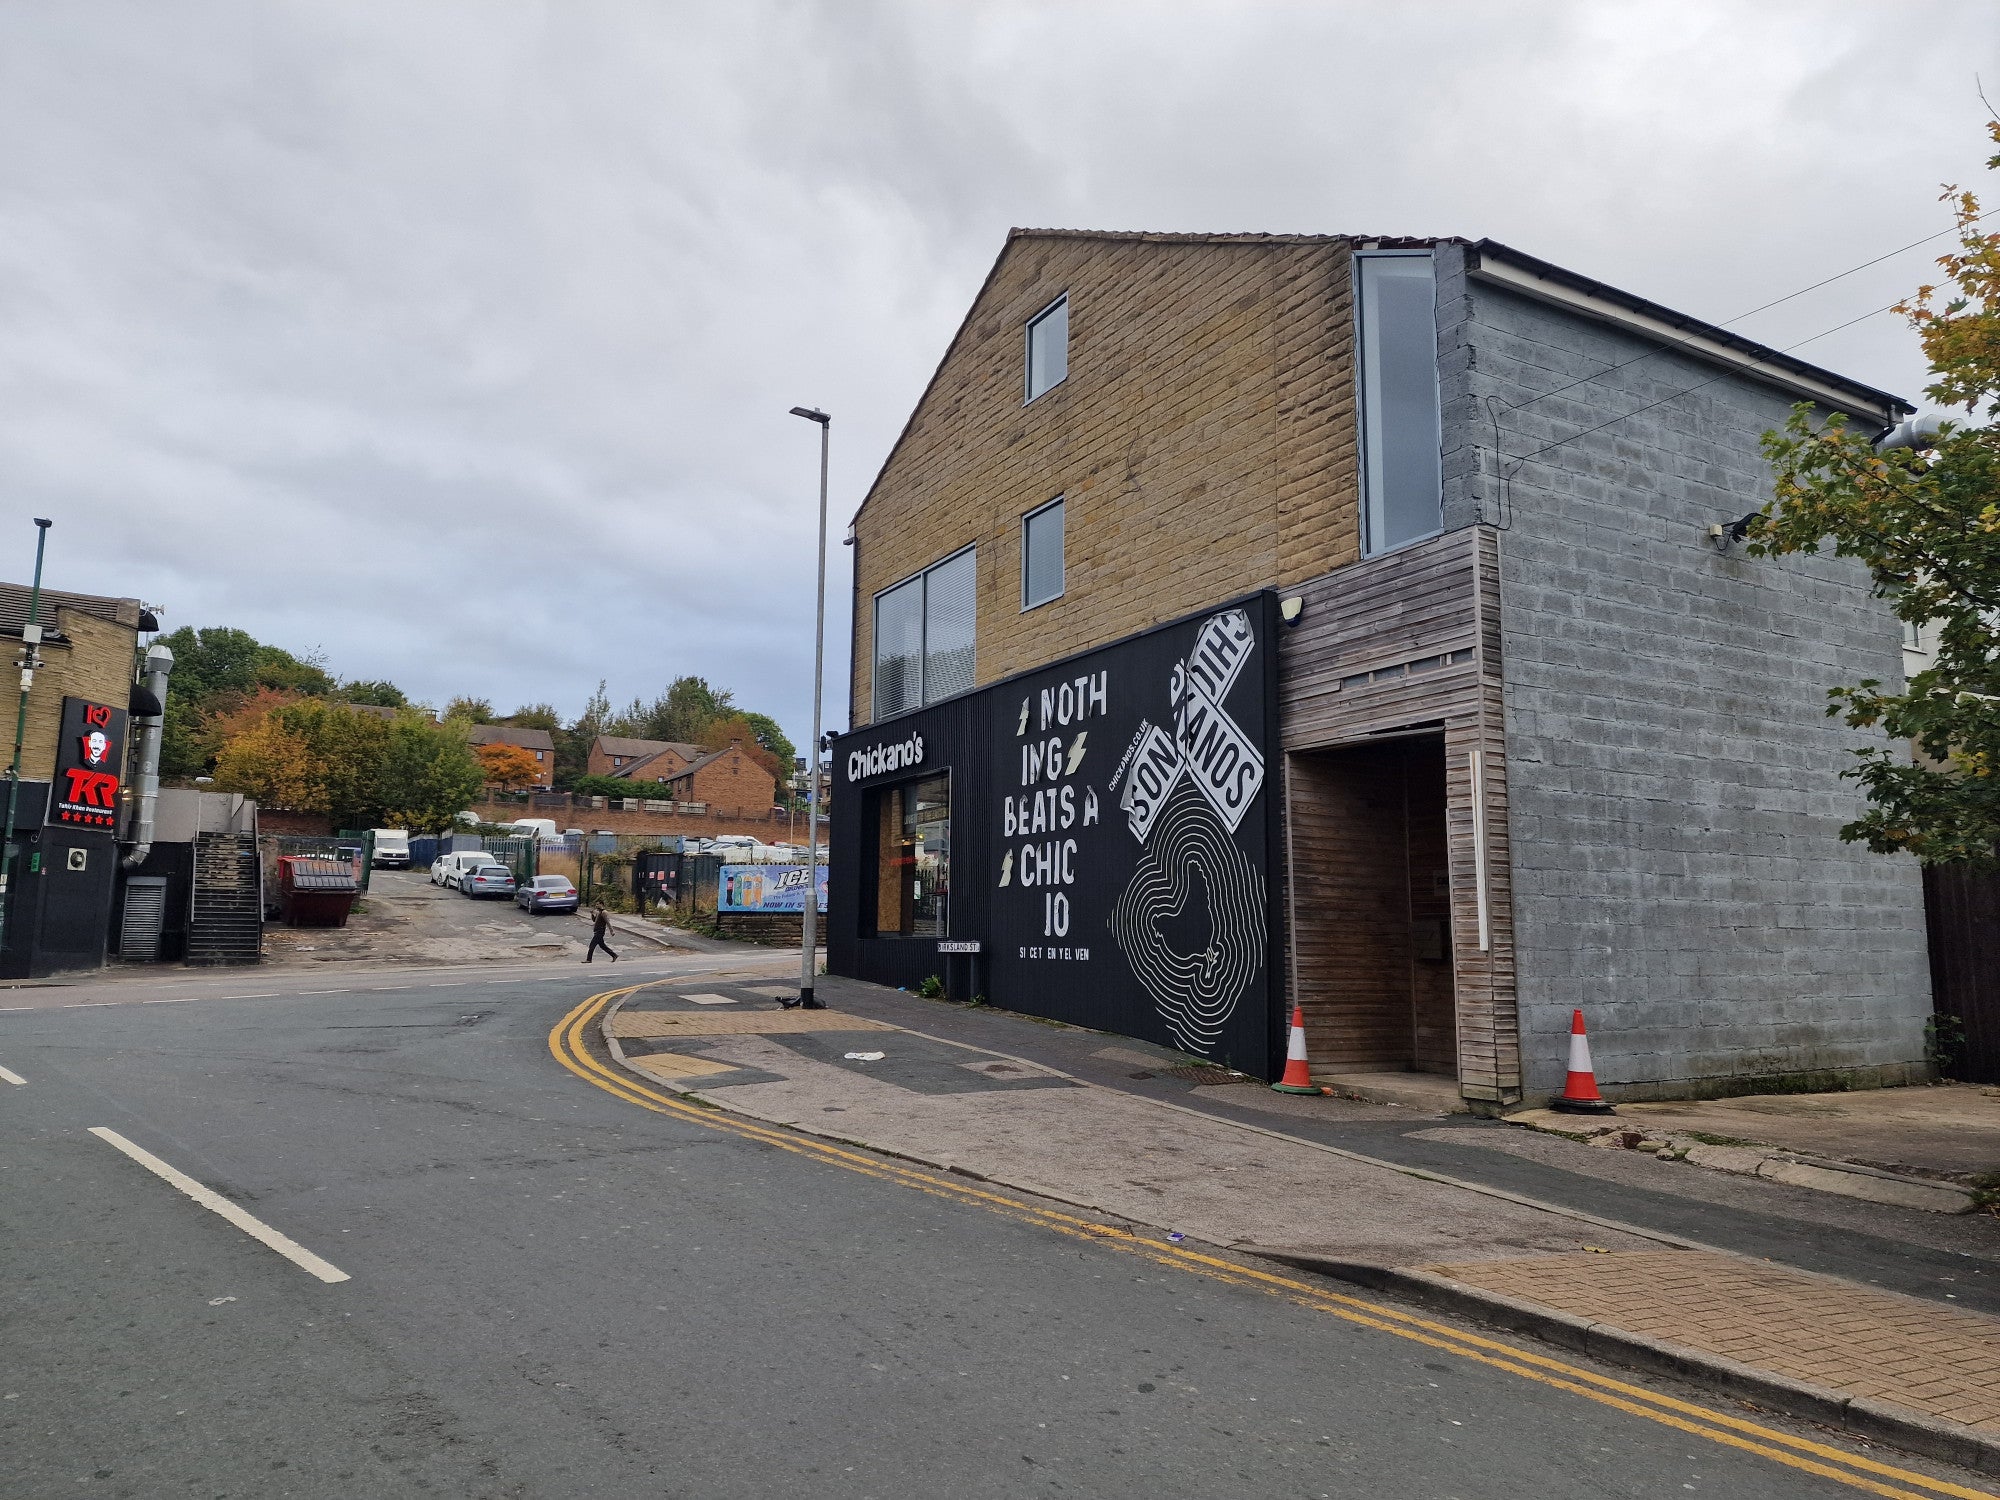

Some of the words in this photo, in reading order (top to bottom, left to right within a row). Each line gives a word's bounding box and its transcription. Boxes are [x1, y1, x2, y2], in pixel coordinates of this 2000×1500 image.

[1040, 670, 1107, 731] NOTH
[848, 731, 923, 782] Chickano's
[1022, 737, 1062, 786] ING
[1108, 717, 1150, 792] CHICKANOS.CO.UK
[66, 768, 119, 808] TKR
[1004, 785, 1075, 837] BEATS
[1083, 785, 1099, 827] A
[1020, 838, 1077, 887] CHIC
